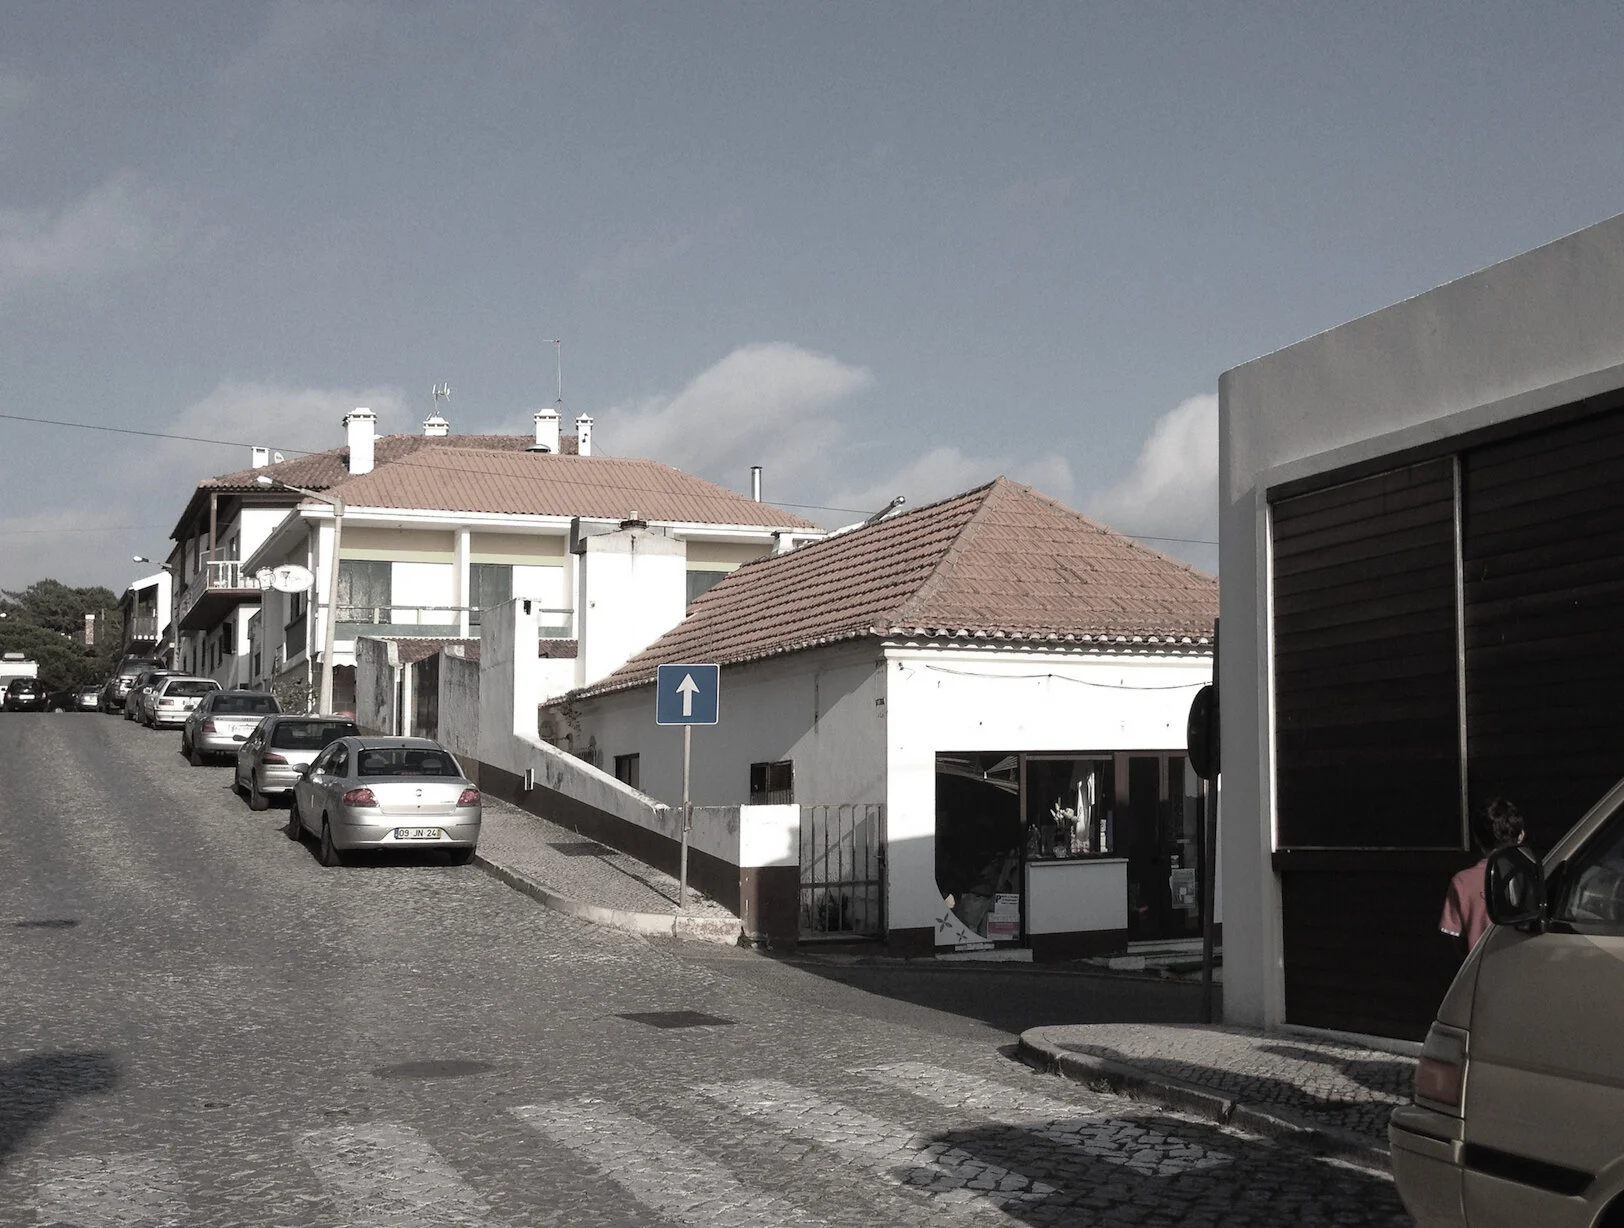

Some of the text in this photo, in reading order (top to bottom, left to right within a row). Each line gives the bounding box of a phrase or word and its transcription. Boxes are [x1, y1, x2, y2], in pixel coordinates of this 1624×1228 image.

[399, 829, 436, 837] 09 JN 24
